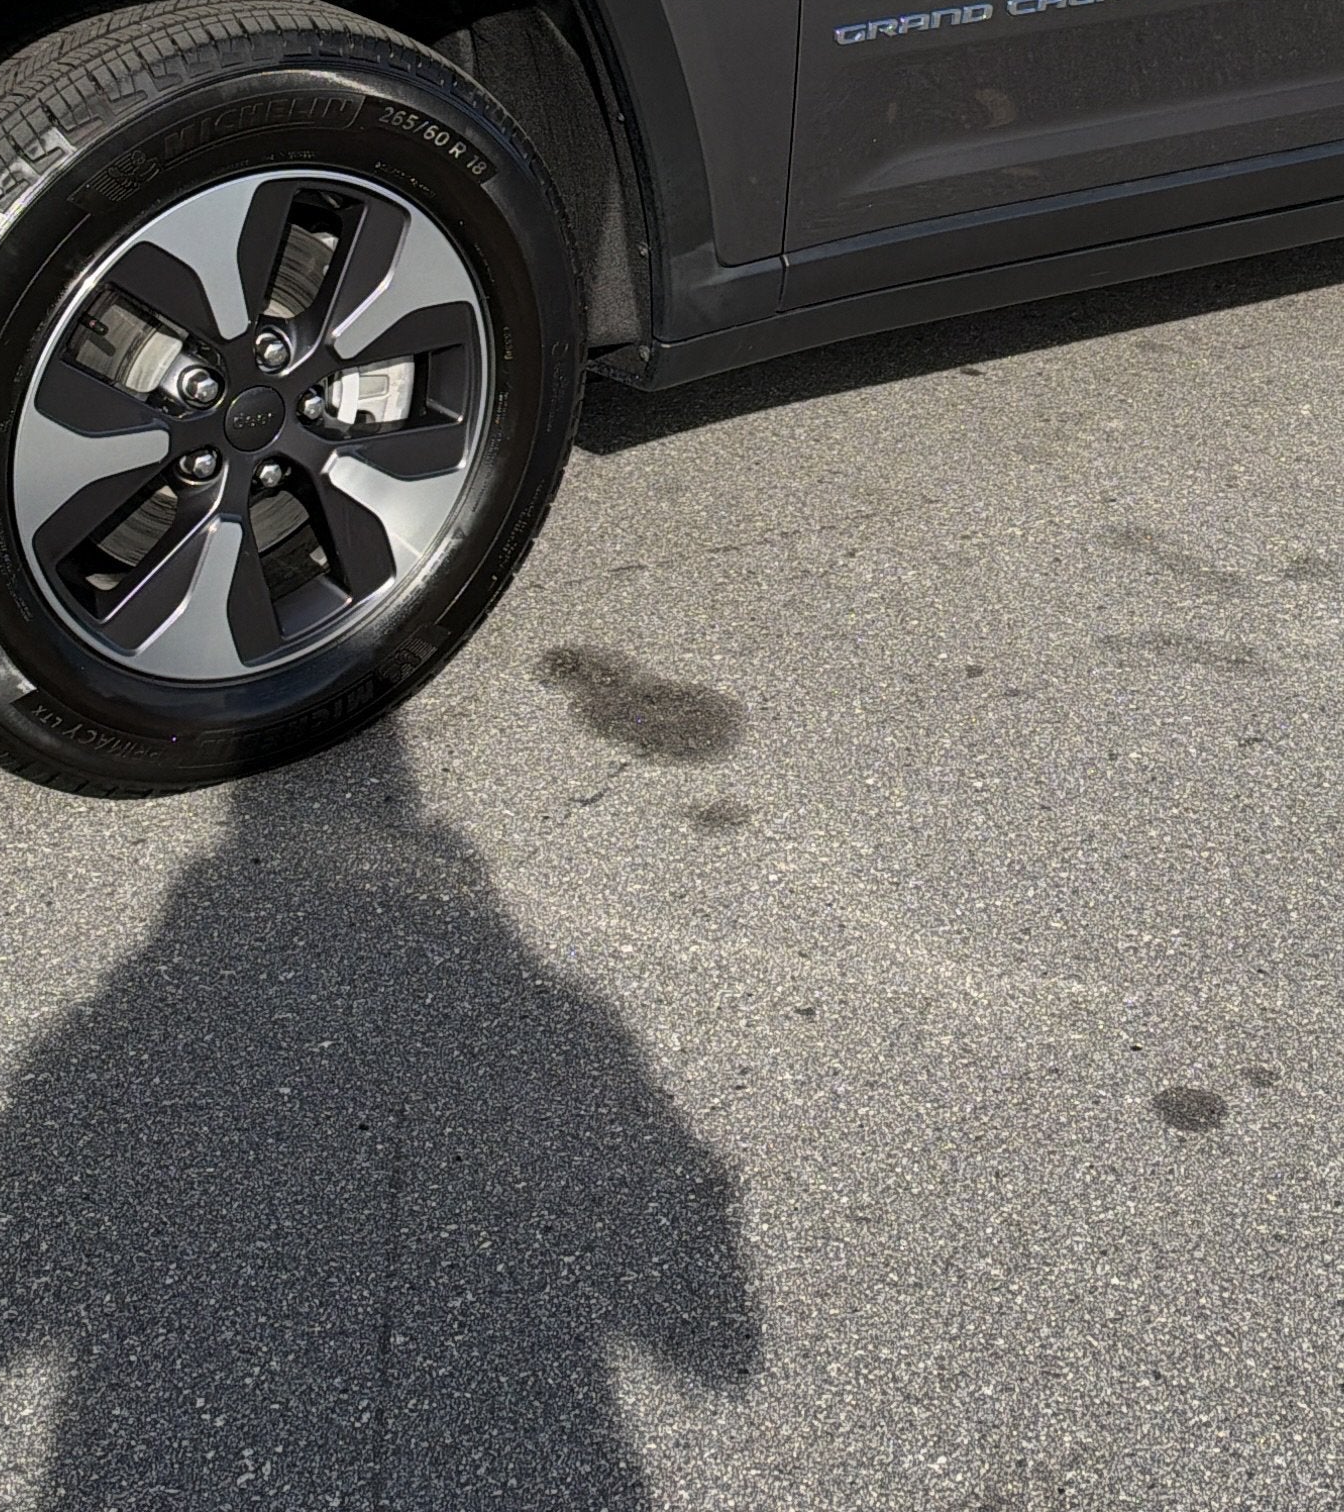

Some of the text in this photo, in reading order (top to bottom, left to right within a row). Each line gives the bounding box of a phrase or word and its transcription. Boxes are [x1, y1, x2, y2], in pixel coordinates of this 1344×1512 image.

[834, 3, 993, 46] GRAND
[163, 96, 355, 159] MICHELIN
[378, 106, 488, 176] 265/60 R 18
